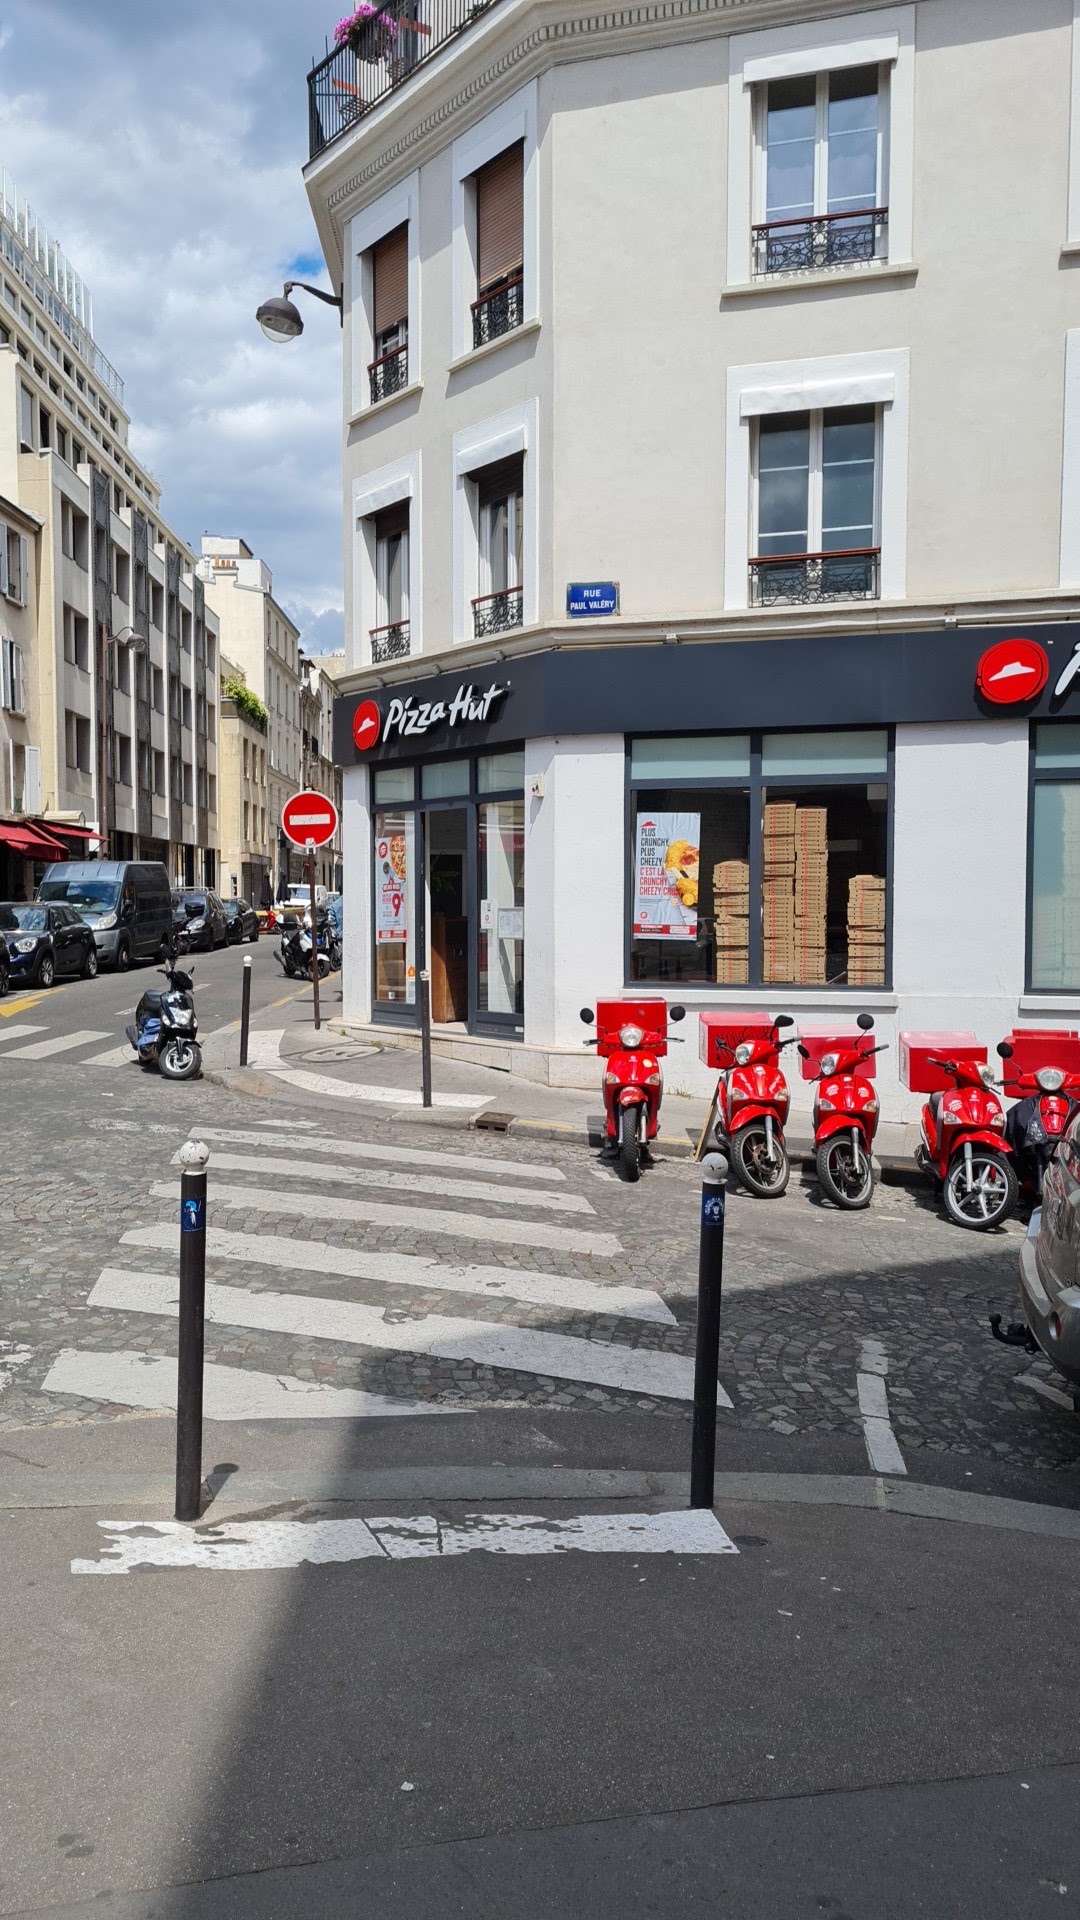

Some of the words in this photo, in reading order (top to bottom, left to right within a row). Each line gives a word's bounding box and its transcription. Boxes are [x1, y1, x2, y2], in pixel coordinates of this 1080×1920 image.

[583, 589, 601, 598] RUE
[570, 602, 587, 610] PAUL
[589, 599, 614, 609] VALÉRY
[382, 696, 447, 743] Pizza
[448, 683, 504, 727] Hut
[641, 828, 656, 836] PLUS
[640, 848, 656, 856] PLUS
[640, 867, 656, 876] C'EST
[657, 867, 665, 876] LA
[640, 877, 668, 886] CRUNCHY
[640, 887, 662, 896] CHEEZY
